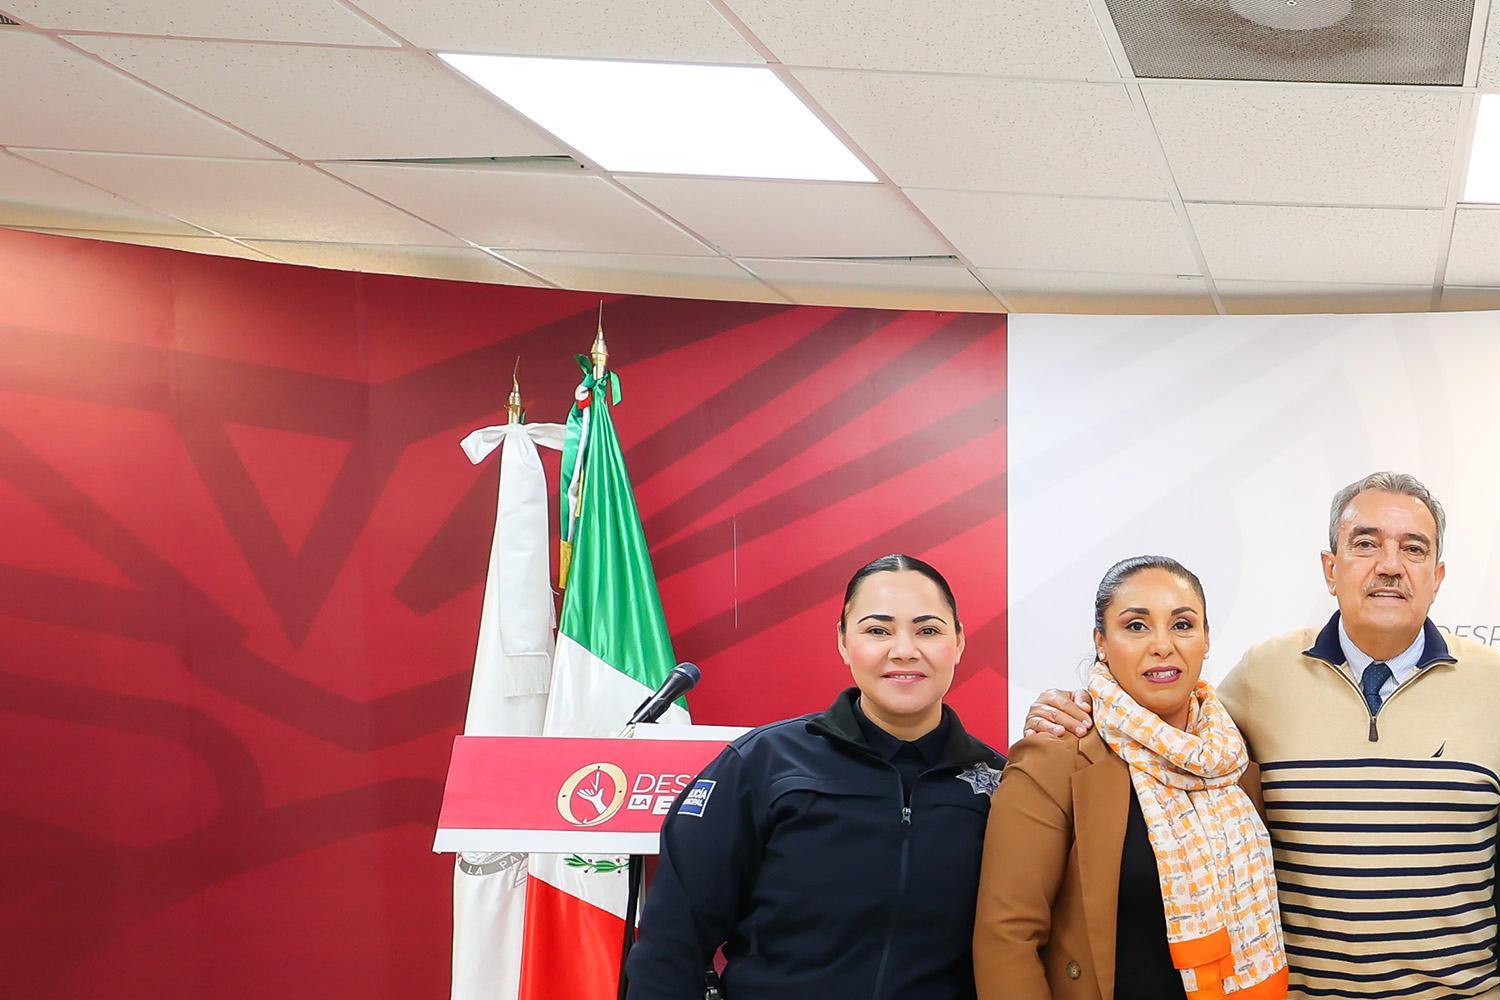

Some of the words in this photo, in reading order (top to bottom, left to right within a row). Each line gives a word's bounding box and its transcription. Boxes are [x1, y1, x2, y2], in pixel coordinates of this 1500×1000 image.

[632, 773, 698, 794] DES
[631, 797, 648, 806] LA
[467, 865, 483, 875] LA
